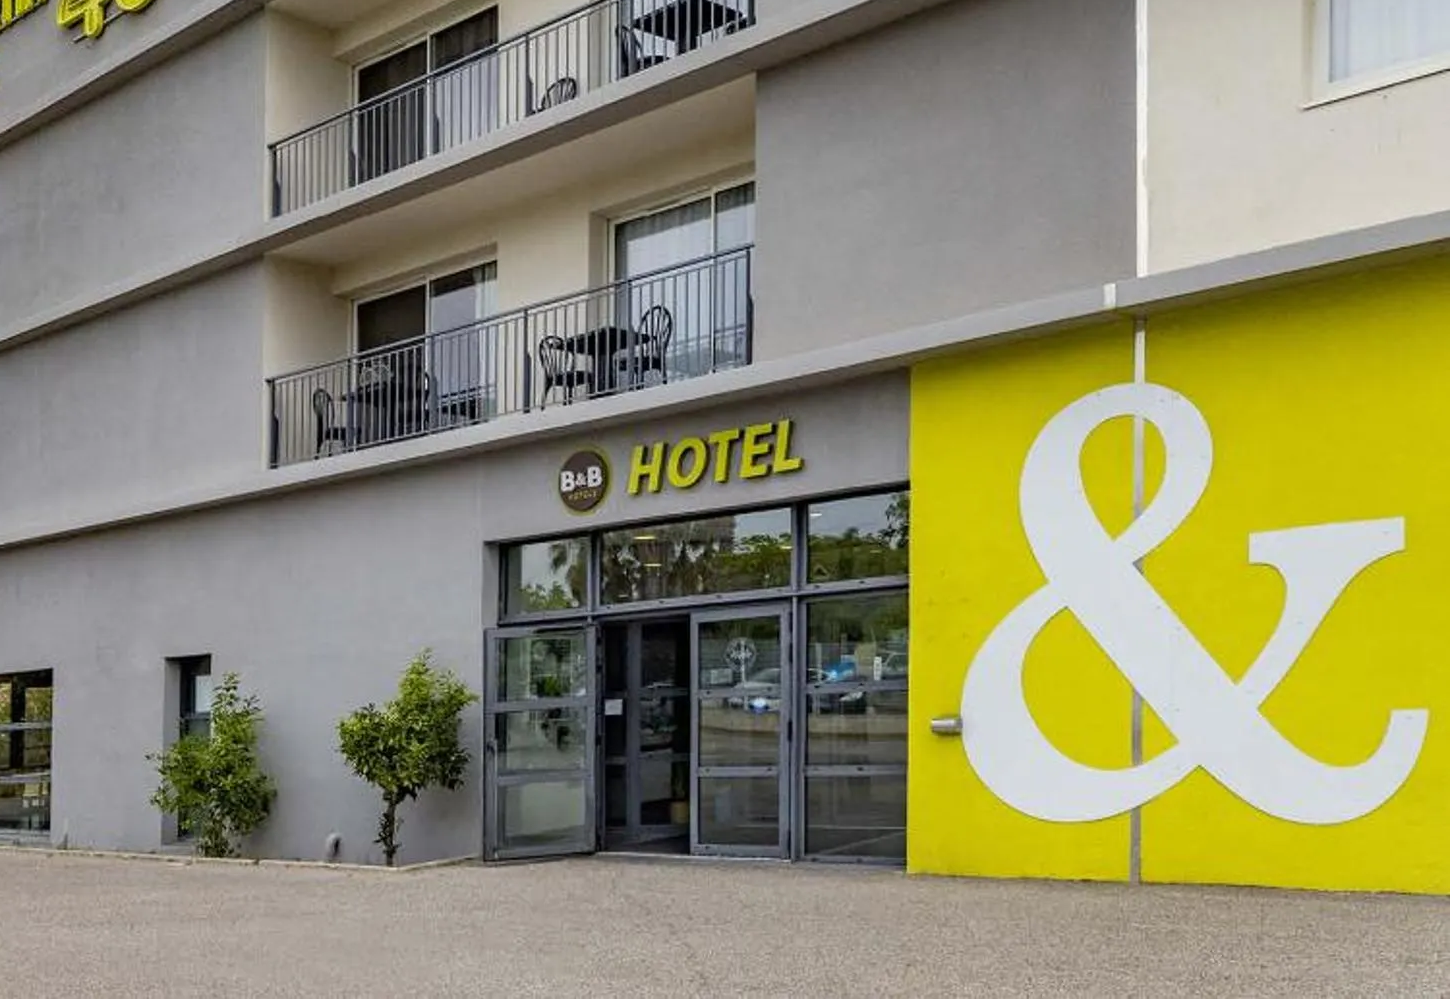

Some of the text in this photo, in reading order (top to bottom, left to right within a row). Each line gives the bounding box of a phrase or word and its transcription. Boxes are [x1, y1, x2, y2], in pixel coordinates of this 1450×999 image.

[560, 465, 603, 492] B&B
[627, 418, 804, 495] HOTEL
[961, 382, 1429, 825] &
